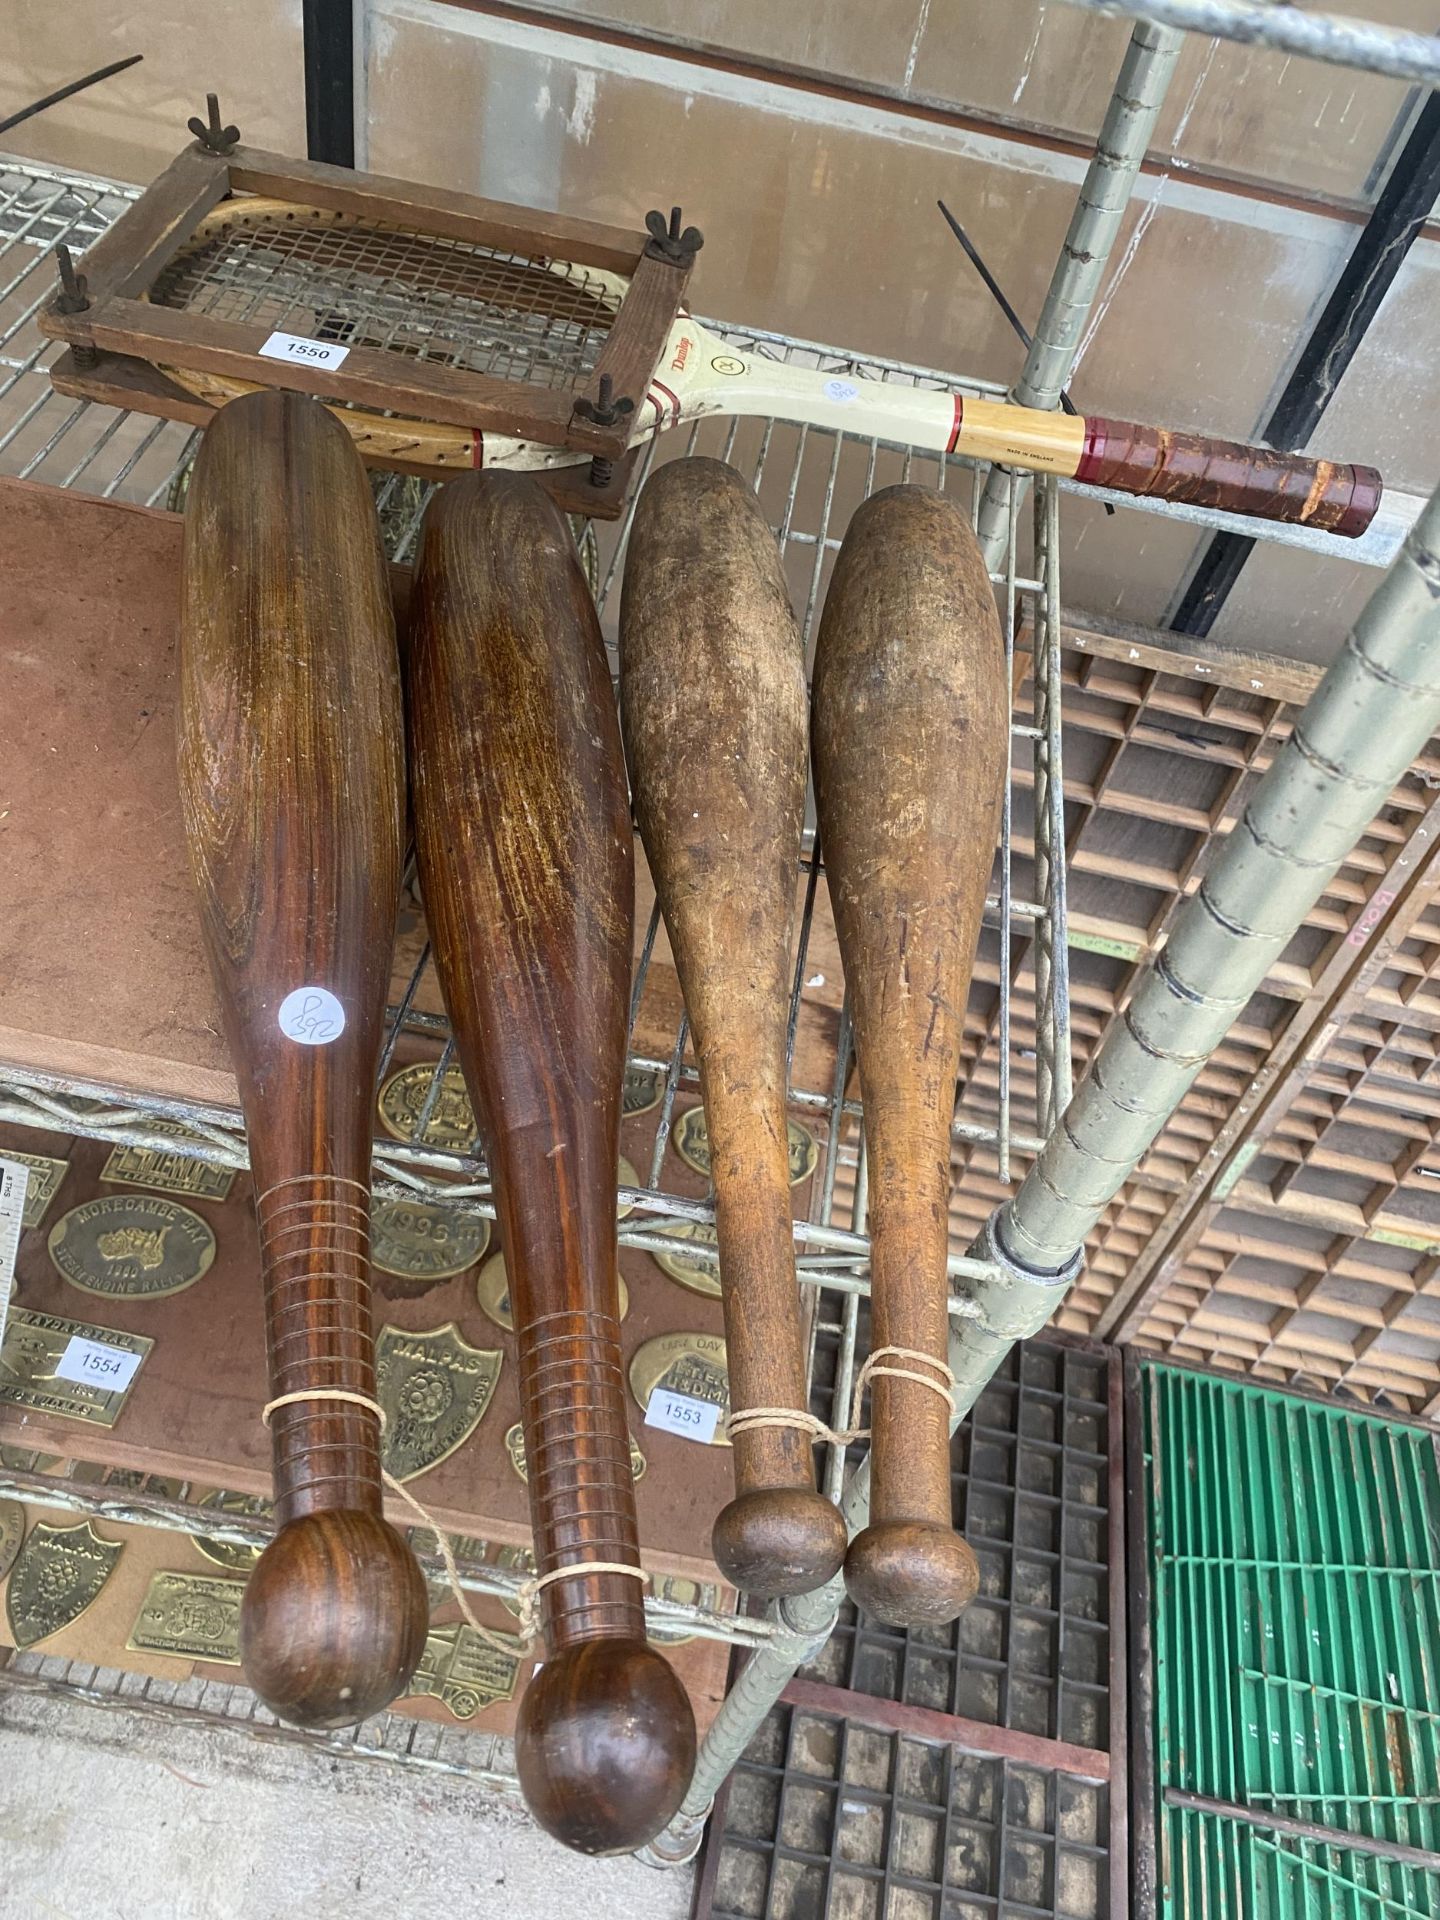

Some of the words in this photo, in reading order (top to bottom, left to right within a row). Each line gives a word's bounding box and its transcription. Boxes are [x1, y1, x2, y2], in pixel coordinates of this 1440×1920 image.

[287, 343, 330, 359] 1550
[671, 337, 693, 372] Dunlop
[76, 1199, 181, 1224] MORECAMBE
[181, 1218, 208, 1244] BAY
[55, 1247, 86, 1281] STEAM
[86, 1275, 136, 1293] ENGINE
[142, 1272, 185, 1292] RALLY
[21, 1312, 82, 1334] MAYDAY
[82, 1325, 133, 1346] STEAM
[696, 1339, 724, 1352] DAY
[81, 1353, 122, 1375] 1554
[392, 1337, 482, 1374] MALPAS
[666, 1402, 702, 1425] 1553
